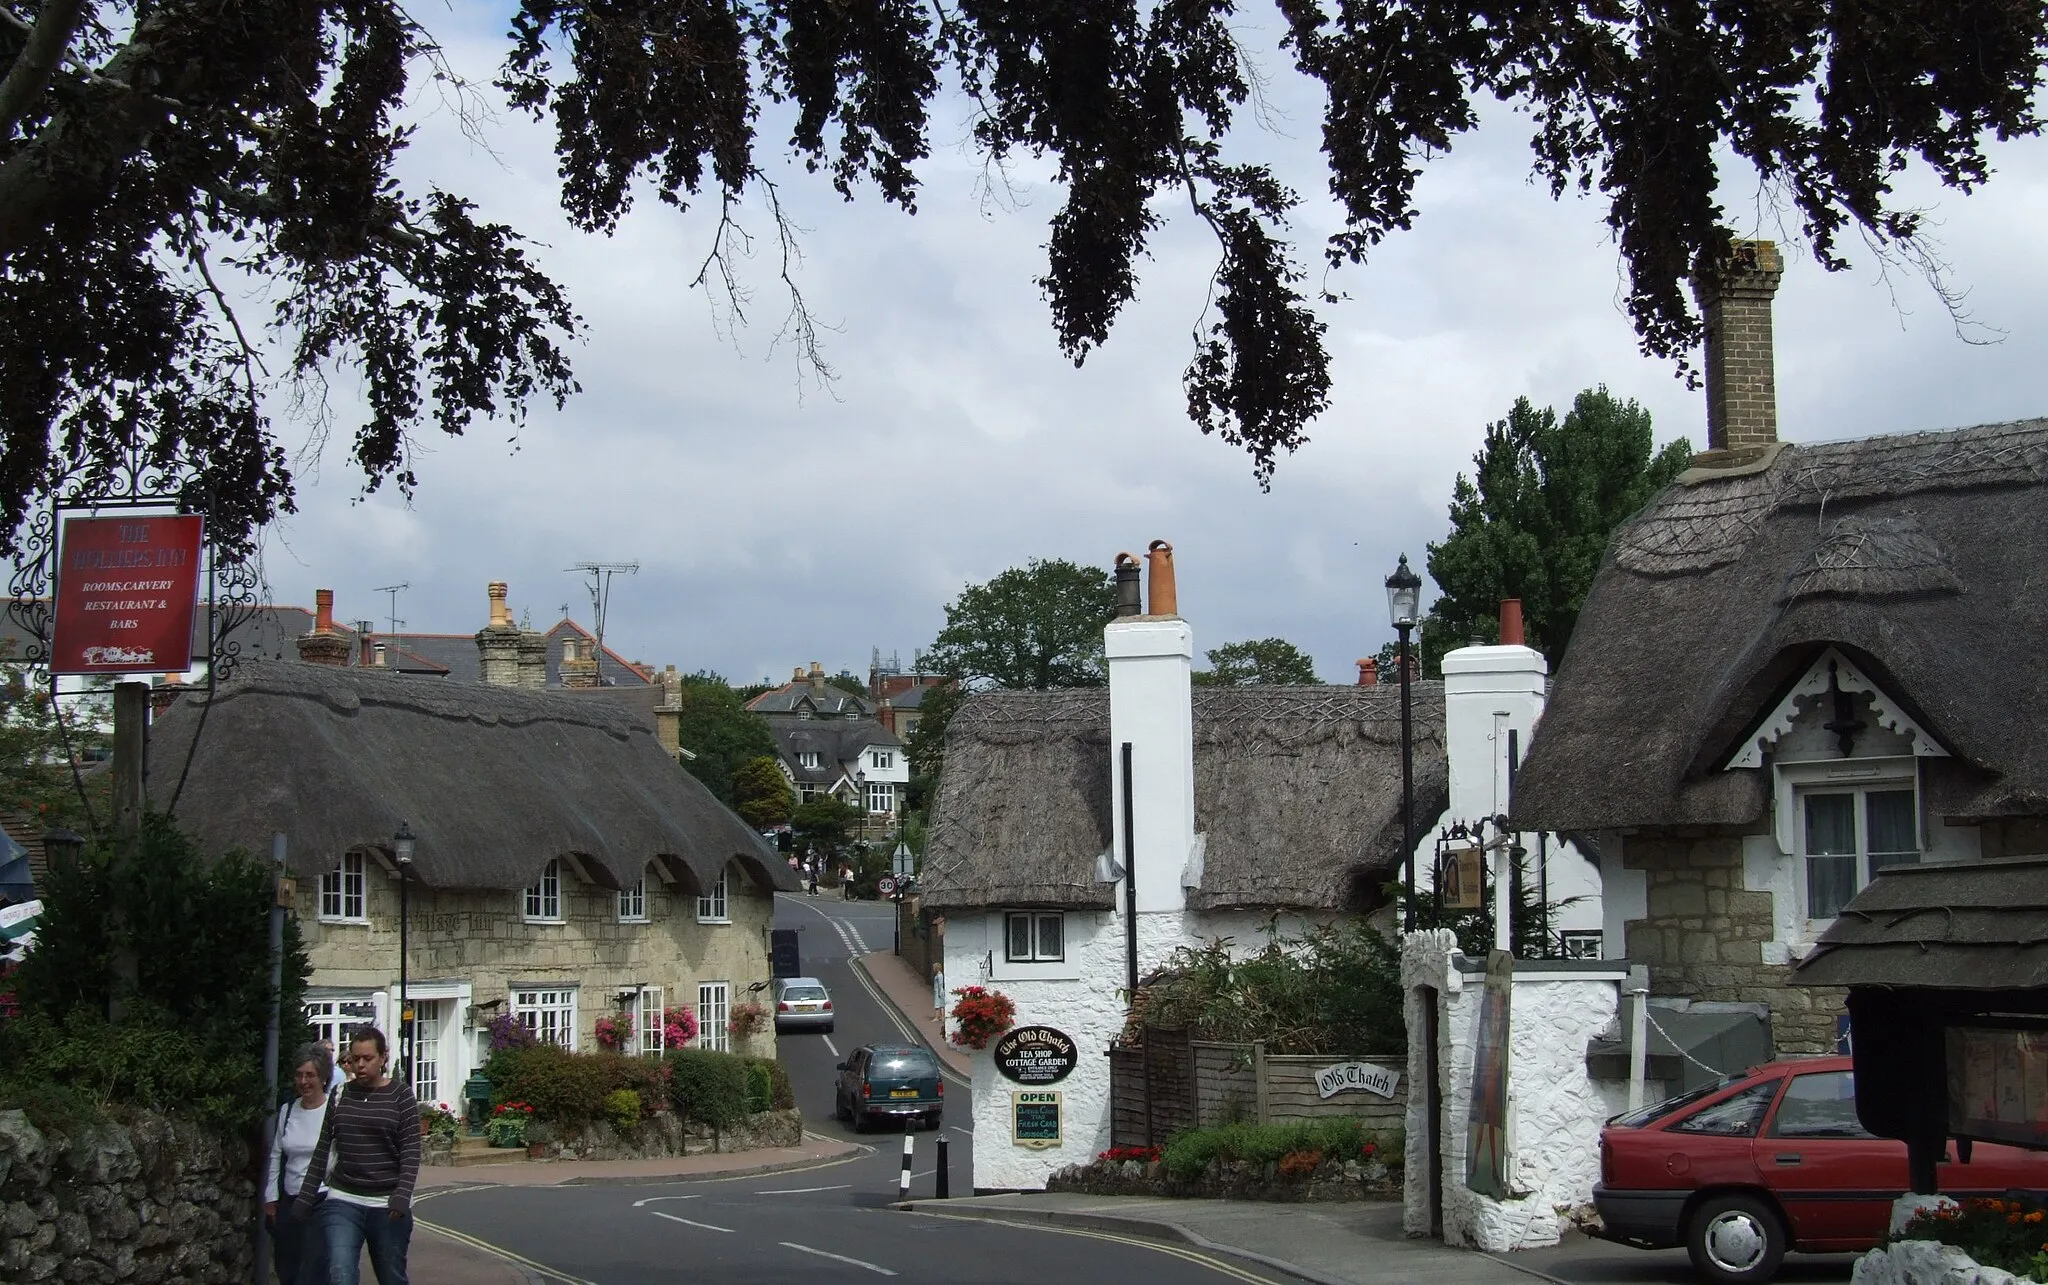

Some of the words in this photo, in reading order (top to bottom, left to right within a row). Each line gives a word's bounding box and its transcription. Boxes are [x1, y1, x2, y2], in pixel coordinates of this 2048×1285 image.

[119, 524, 150, 543] THE
[84, 600, 157, 611] RESTAURANT
[157, 599, 167, 609] &
[109, 619, 139, 630] BARS
[881, 881, 893, 889] 30
[1000, 1039, 1018, 1055] The
[1018, 1030, 1037, 1043] Old
[1038, 1029, 1071, 1054] Thatch
[1019, 1050, 1033, 1058] TEA
[1034, 1050, 1053, 1058] SHOP
[1005, 1058, 1037, 1067] COTTAGE
[1038, 1057, 1068, 1066] GARDEN
[1321, 1068, 1345, 1092] Old
[1345, 1065, 1390, 1093] Thatch
[1020, 1093, 1056, 1102] OPEN
